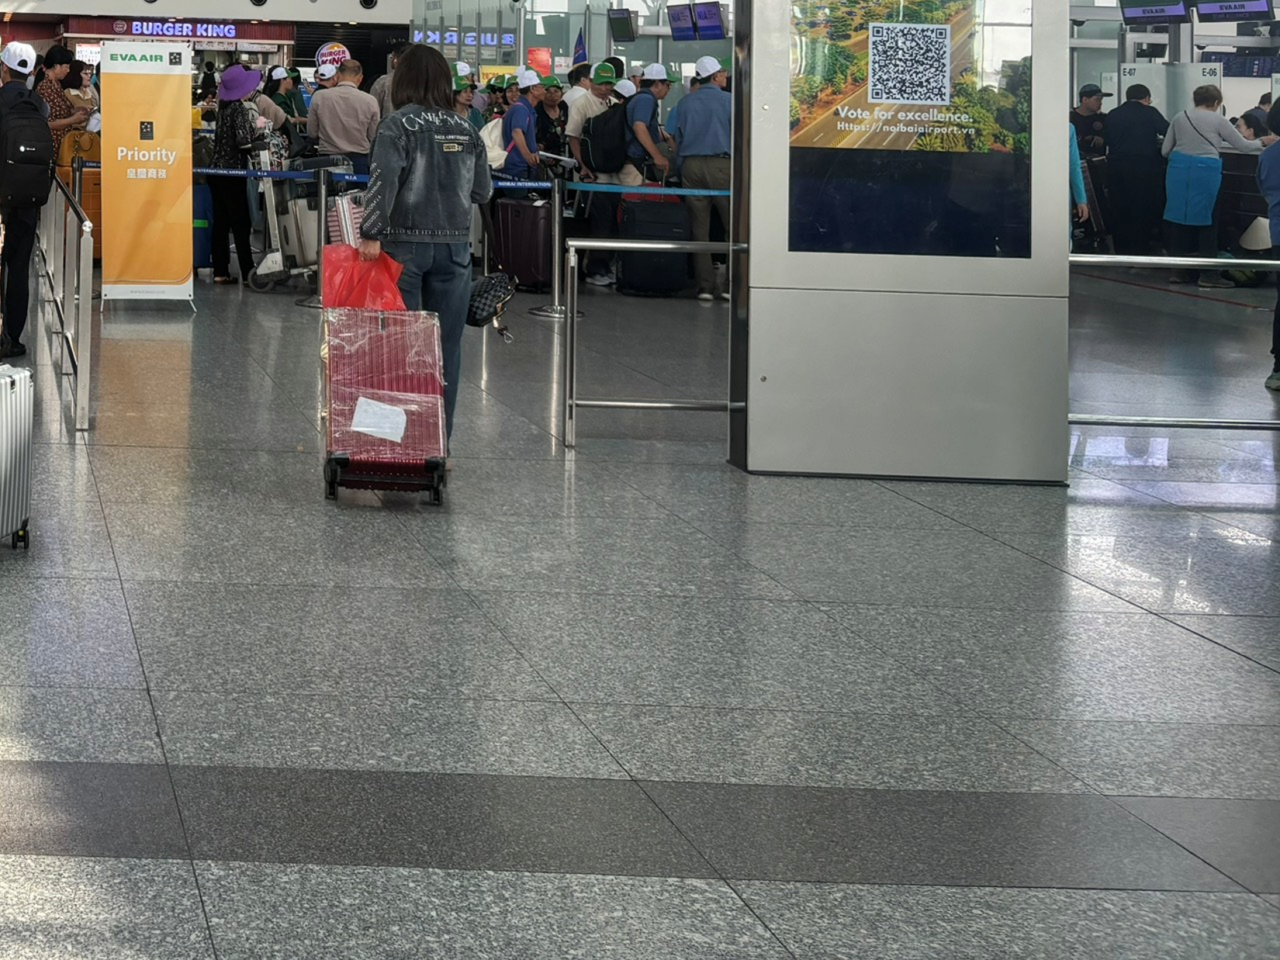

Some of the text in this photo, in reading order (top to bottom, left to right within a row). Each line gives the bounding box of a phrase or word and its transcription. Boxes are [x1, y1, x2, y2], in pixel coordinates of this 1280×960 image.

[131, 21, 192, 36] BURGER
[196, 23, 236, 38] KING
[320, 49, 346, 59] BURGER
[1123, 68, 1136, 77] E-07
[1202, 68, 1217, 77] E-06
[837, 106, 974, 123] Vote for excellence.
[837, 121, 976, 135] Https://noibaiairport.vn
[117, 146, 176, 165] Priority
